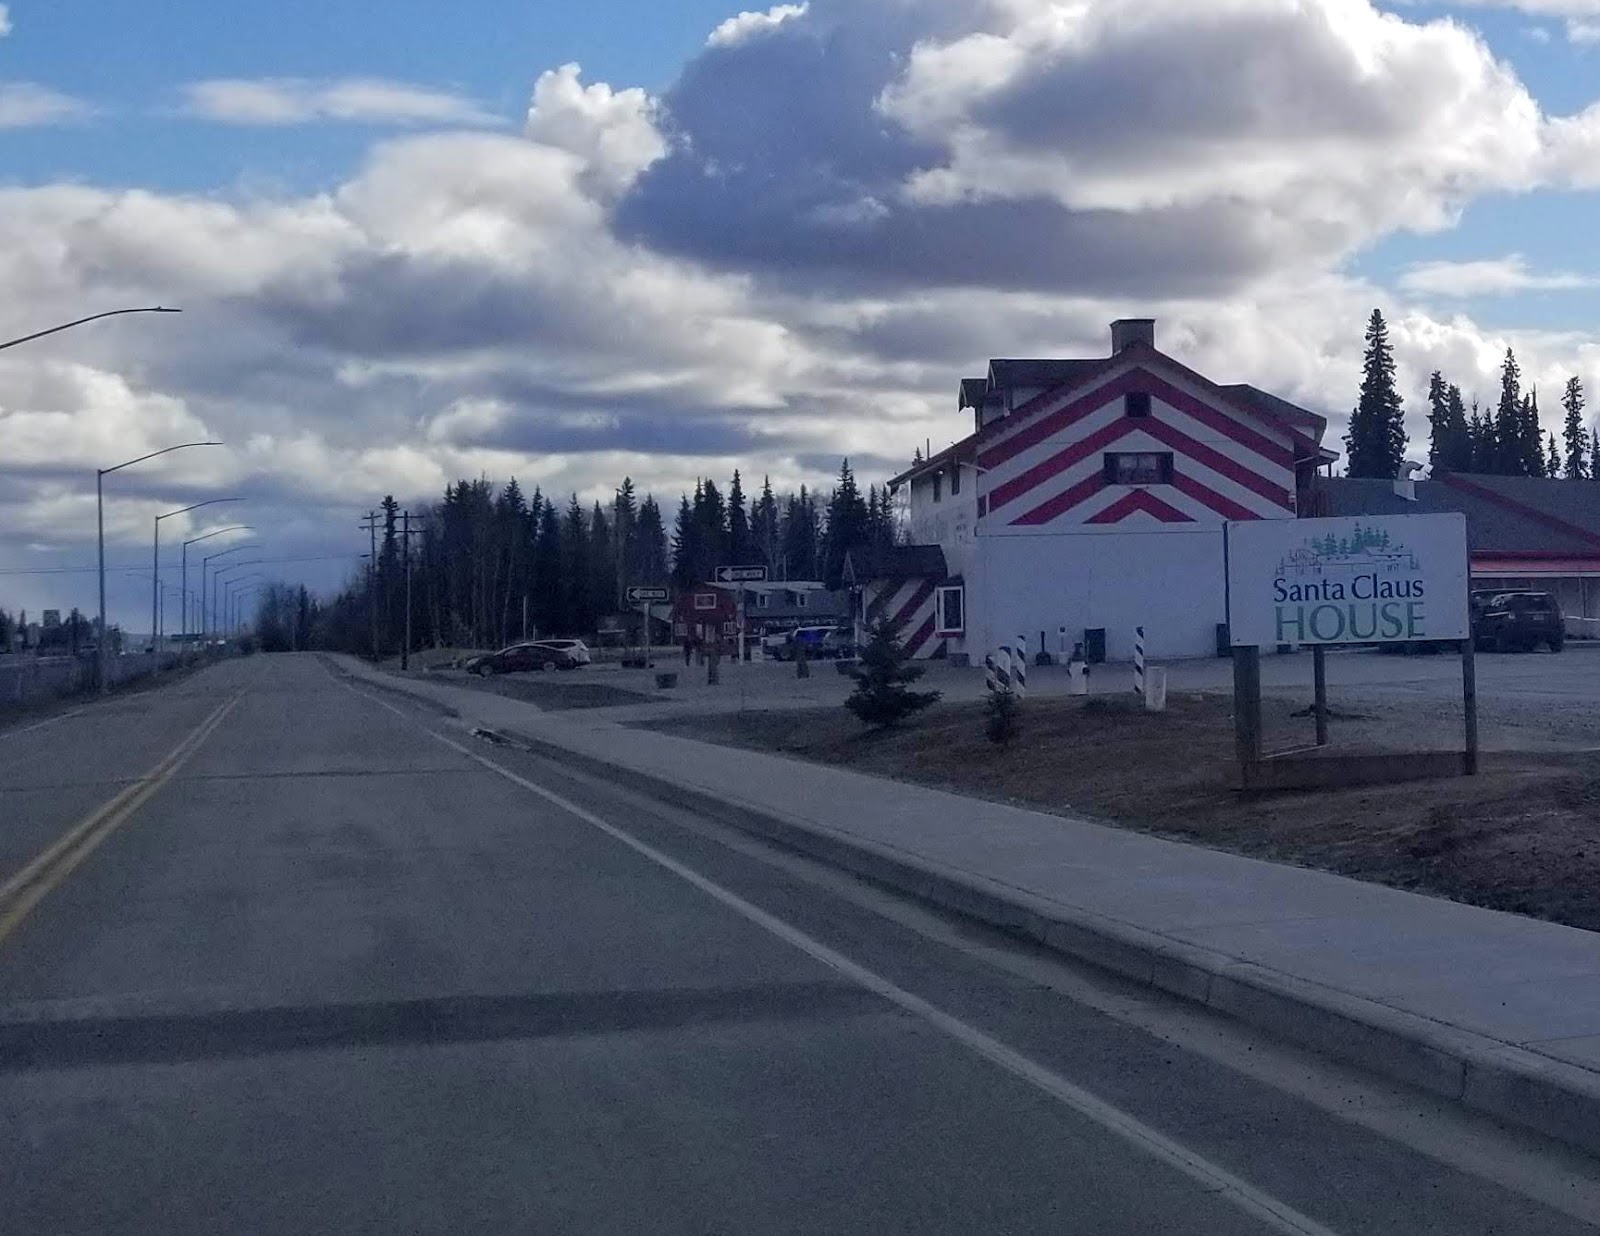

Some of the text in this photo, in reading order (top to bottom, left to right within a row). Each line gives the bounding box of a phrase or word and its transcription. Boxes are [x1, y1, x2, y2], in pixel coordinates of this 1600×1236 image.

[1273, 573, 1424, 602] Santa Claus
[1275, 602, 1425, 641] HOUSE
